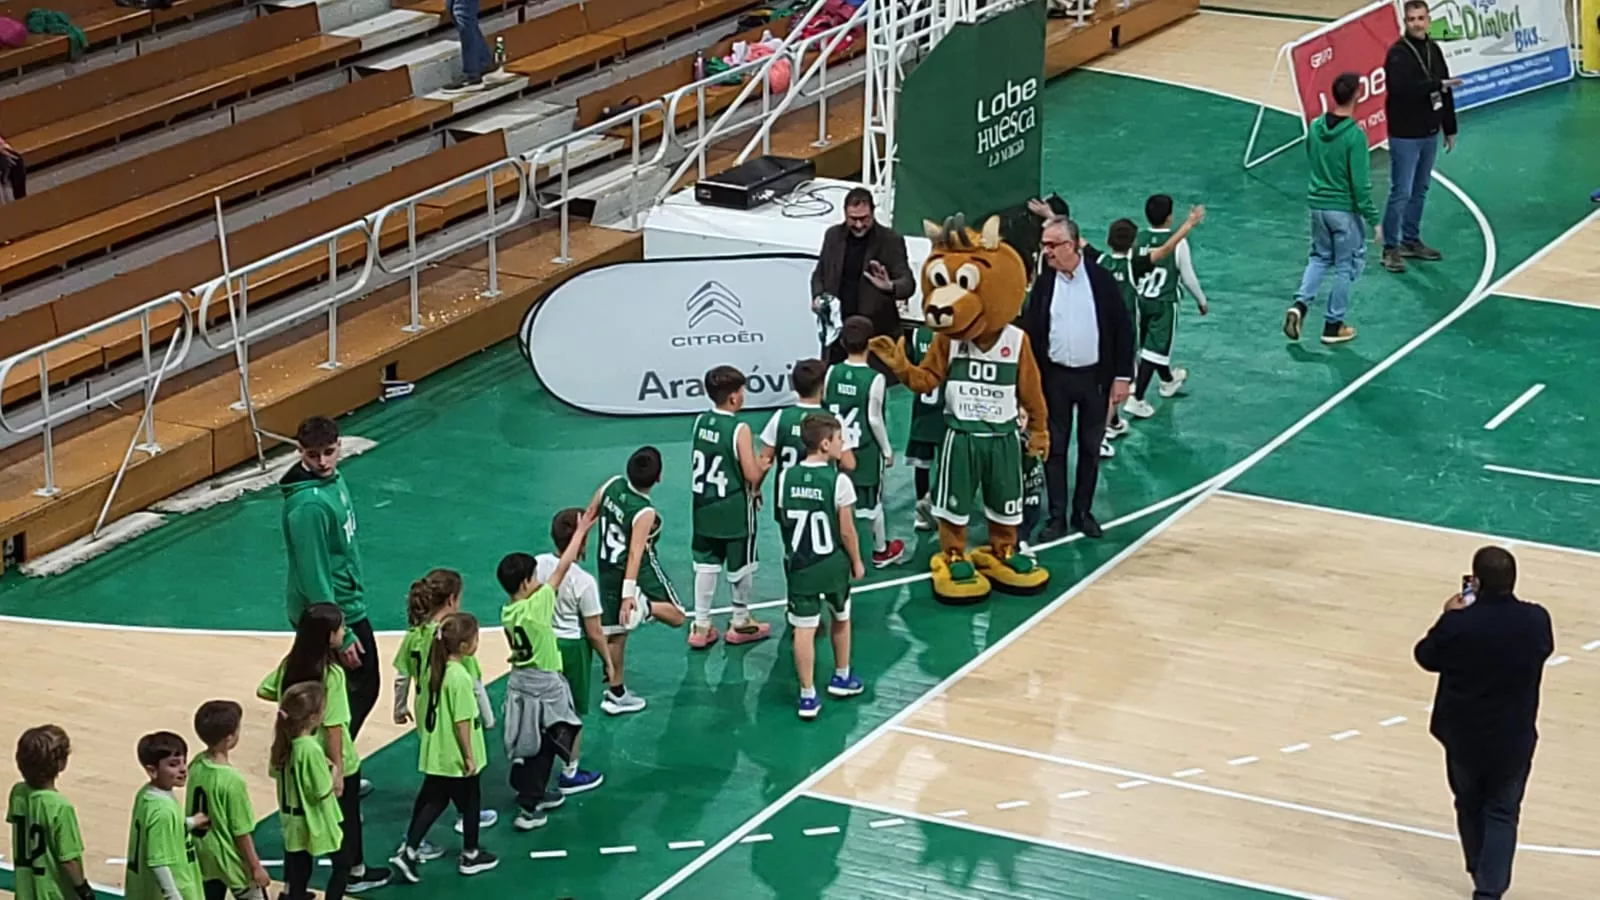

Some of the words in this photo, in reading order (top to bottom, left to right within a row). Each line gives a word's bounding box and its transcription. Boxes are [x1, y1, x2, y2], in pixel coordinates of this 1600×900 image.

[977, 78, 1037, 123] Lobe
[969, 361, 997, 381] 00
[692, 450, 728, 498] 24
[787, 510, 834, 554] 70
